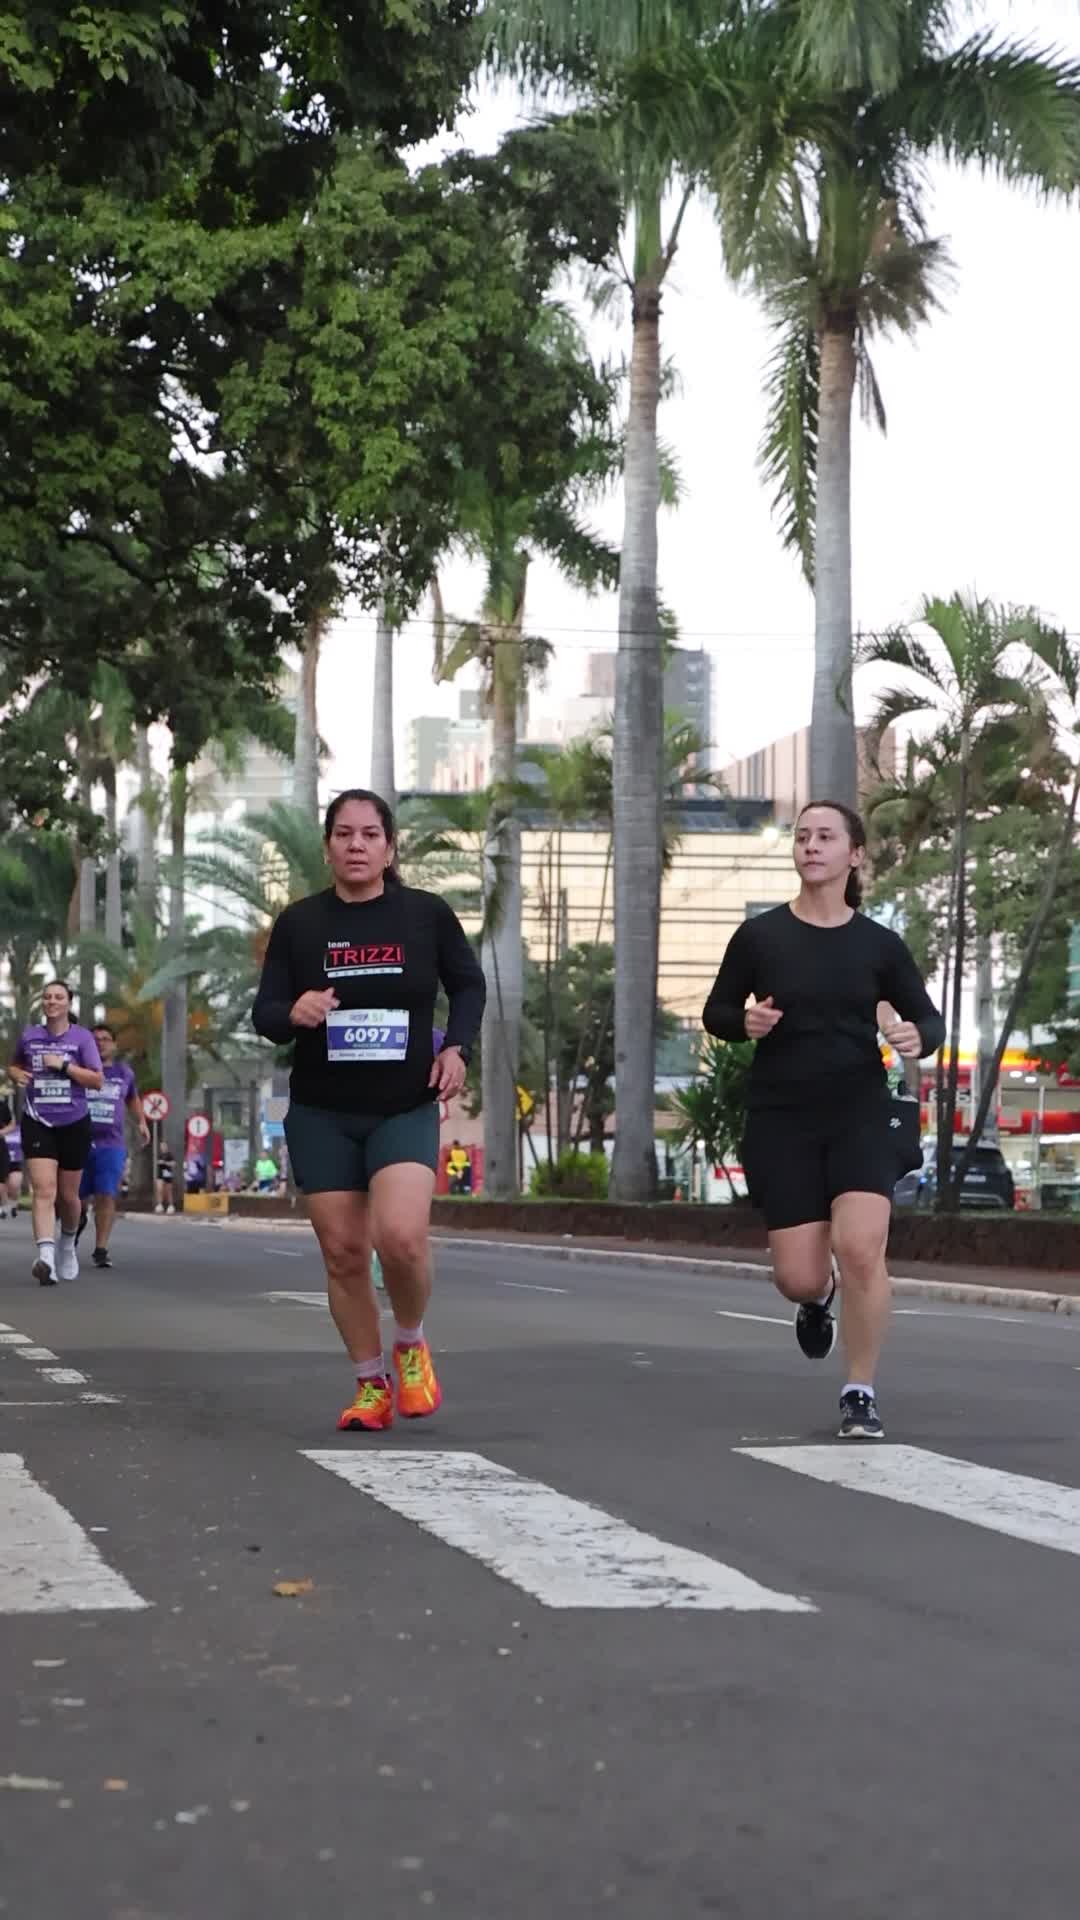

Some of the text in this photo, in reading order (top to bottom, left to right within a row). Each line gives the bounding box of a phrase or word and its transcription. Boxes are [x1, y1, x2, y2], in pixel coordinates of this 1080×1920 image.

[328, 941, 350, 949] team
[330, 947, 401, 966] TRIZZI
[344, 1028, 391, 1043] 6097
